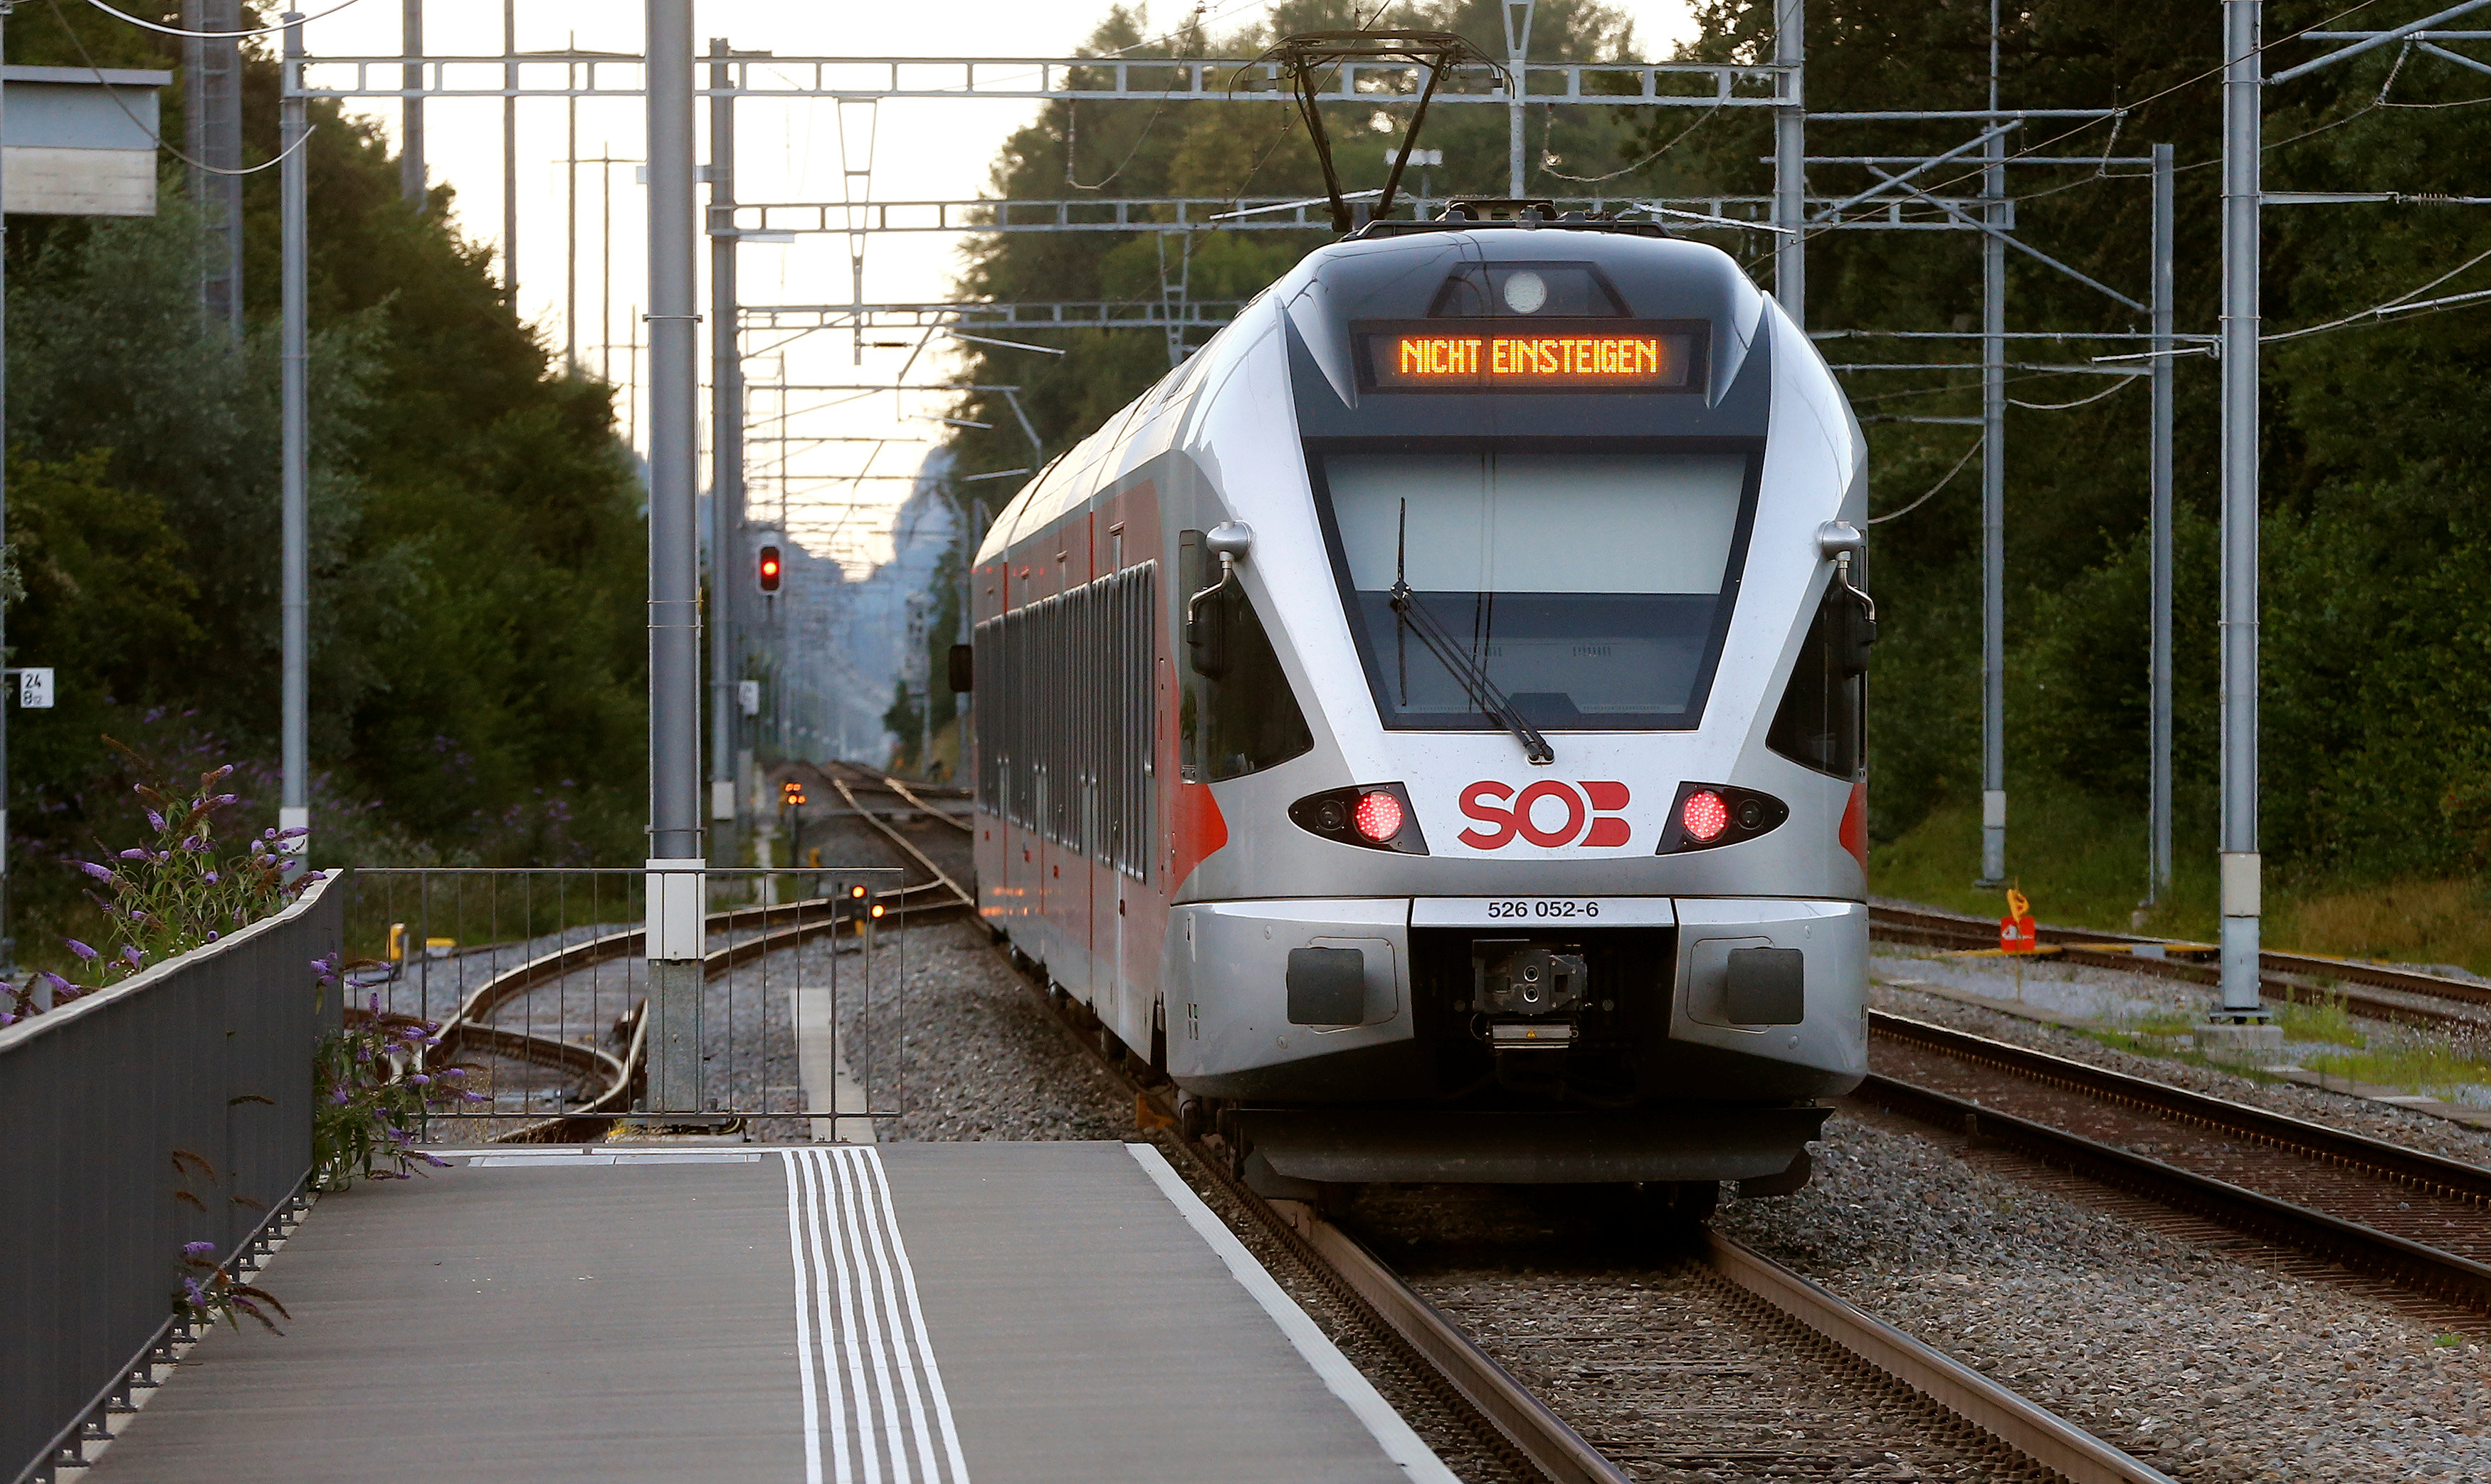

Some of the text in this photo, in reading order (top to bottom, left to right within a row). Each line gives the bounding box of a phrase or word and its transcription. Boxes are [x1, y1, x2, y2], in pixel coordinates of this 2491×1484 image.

[1400, 338, 1658, 374] NICHT EINSTEIGEN
[26, 673, 41, 689] 24
[1457, 780, 1631, 850] SOB
[1487, 901, 1599, 917] 526 052-6
